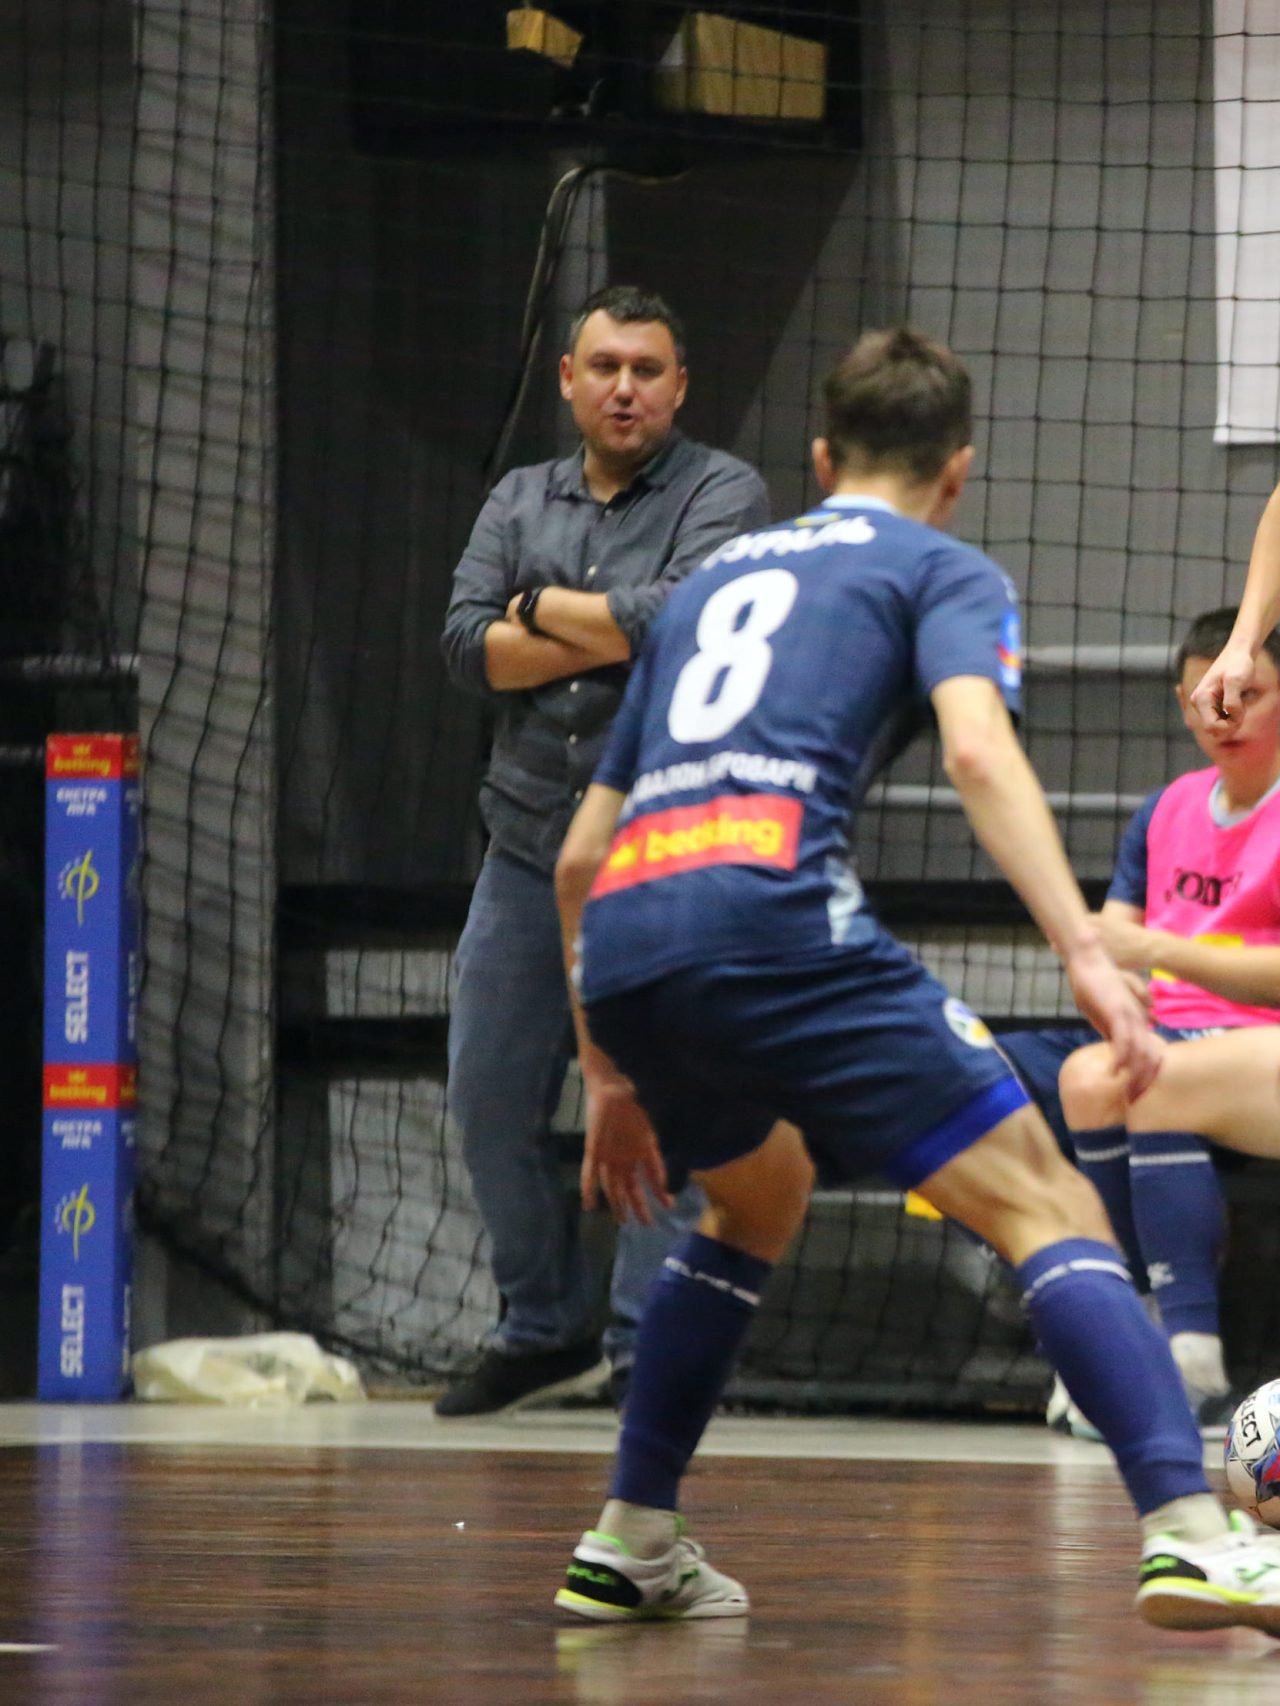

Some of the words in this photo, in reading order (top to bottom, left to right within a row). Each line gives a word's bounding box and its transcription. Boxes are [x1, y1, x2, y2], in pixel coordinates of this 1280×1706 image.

[668, 568, 799, 744] 8
[65, 950, 89, 1044] SELECT
[60, 1284, 85, 1378] SELECT
